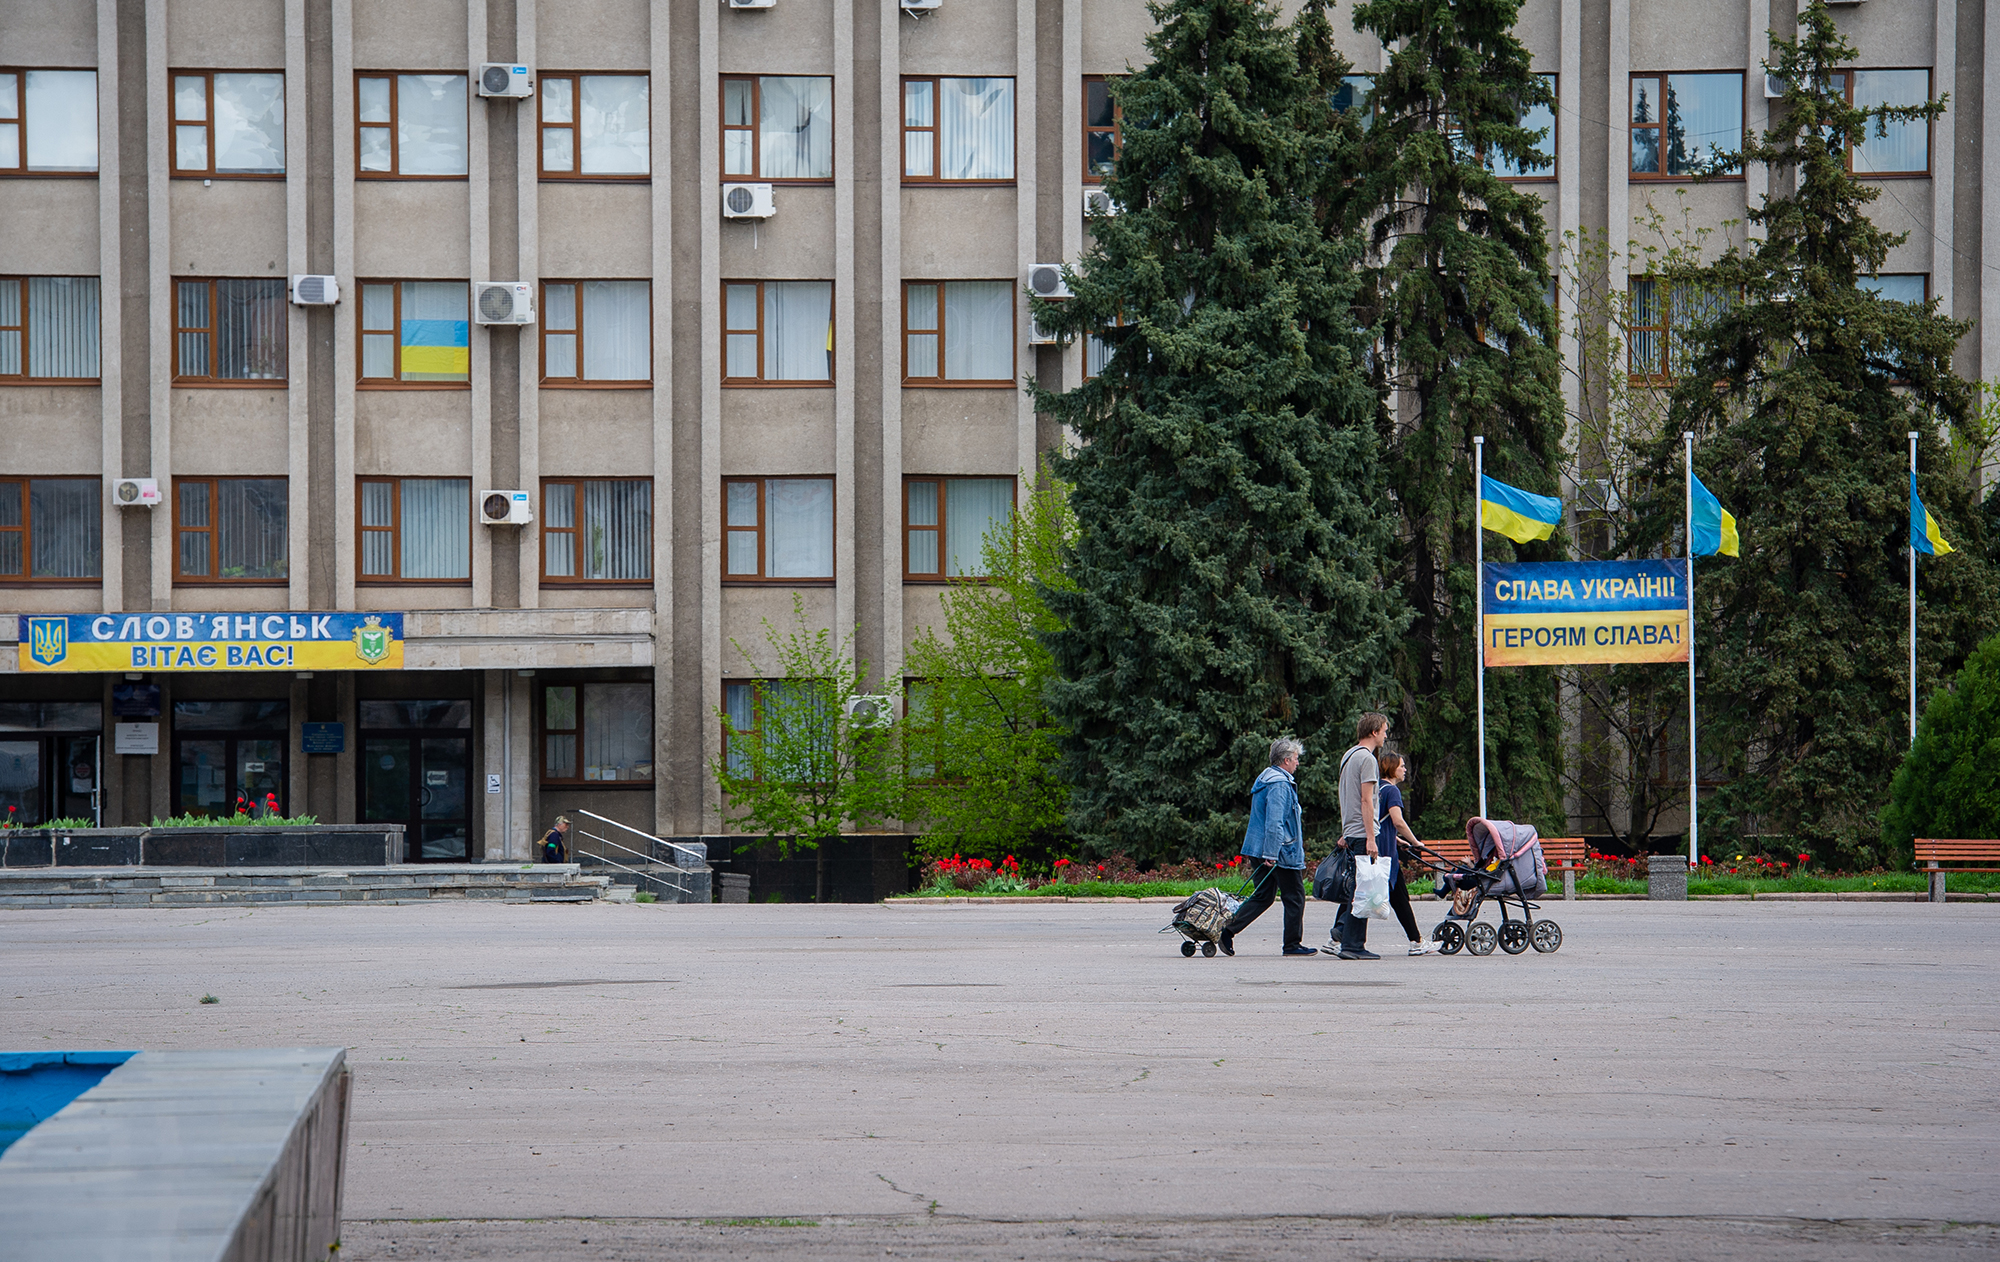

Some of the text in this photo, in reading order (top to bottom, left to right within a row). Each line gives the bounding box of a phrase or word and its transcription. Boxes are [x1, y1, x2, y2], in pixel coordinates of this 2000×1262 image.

[1495, 573, 1676, 601] СЛАВА УКРАЇНІ!
[91, 615, 333, 639] СЛОВ'ЯНСЬК
[1492, 624, 1681, 648] ГЕРОЯМ СЛАВА!
[131, 645, 293, 668] ВІТАЄ ВАС!
